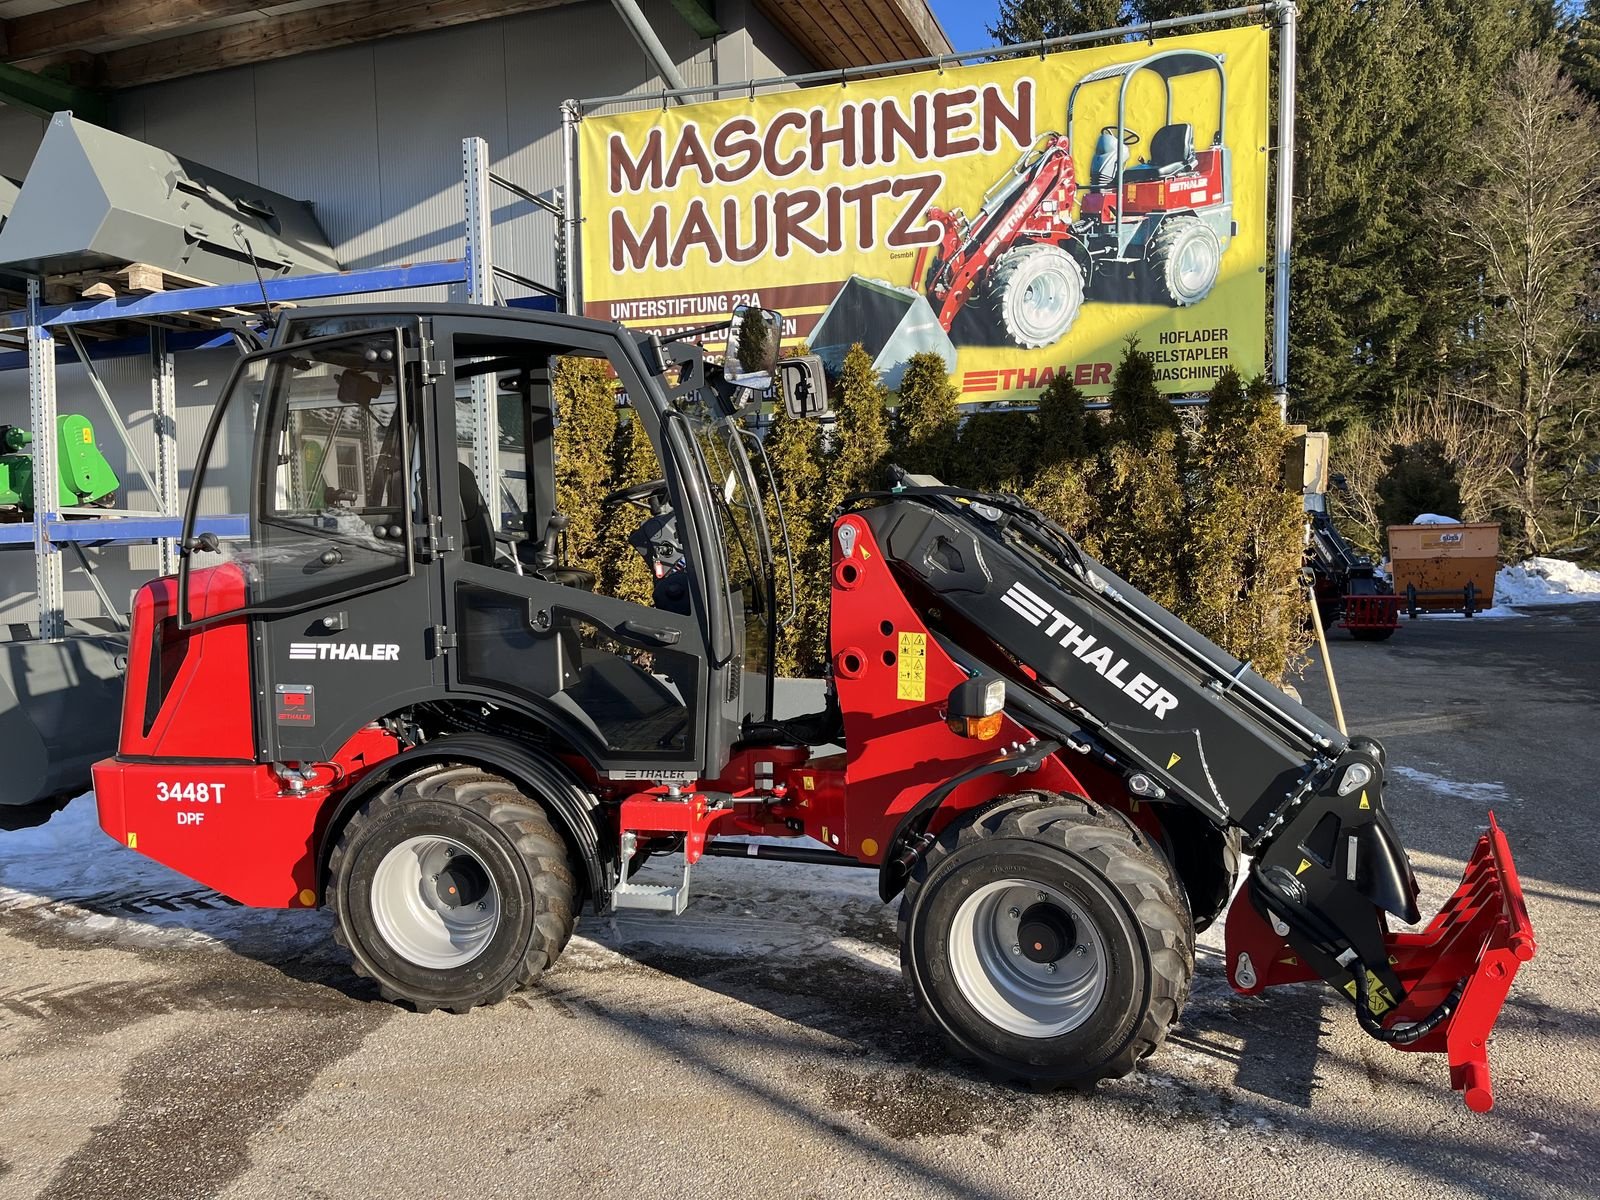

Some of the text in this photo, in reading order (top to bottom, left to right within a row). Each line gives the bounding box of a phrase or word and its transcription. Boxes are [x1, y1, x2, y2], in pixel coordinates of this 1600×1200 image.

[609, 80, 1033, 194] MASCHINEN
[610, 174, 942, 272] MAURITZ
[610, 293, 761, 319] UNTERSTIFTUNG 23A
[1160, 329, 1228, 344] HOFLADER
[1138, 347, 1228, 363] BELSTAPLER
[316, 643, 400, 661] THALER
[1044, 609, 1179, 720] THALER
[641, 770, 684, 779] THALER
[156, 782, 225, 804] 3448T
[177, 812, 204, 825] DPF
